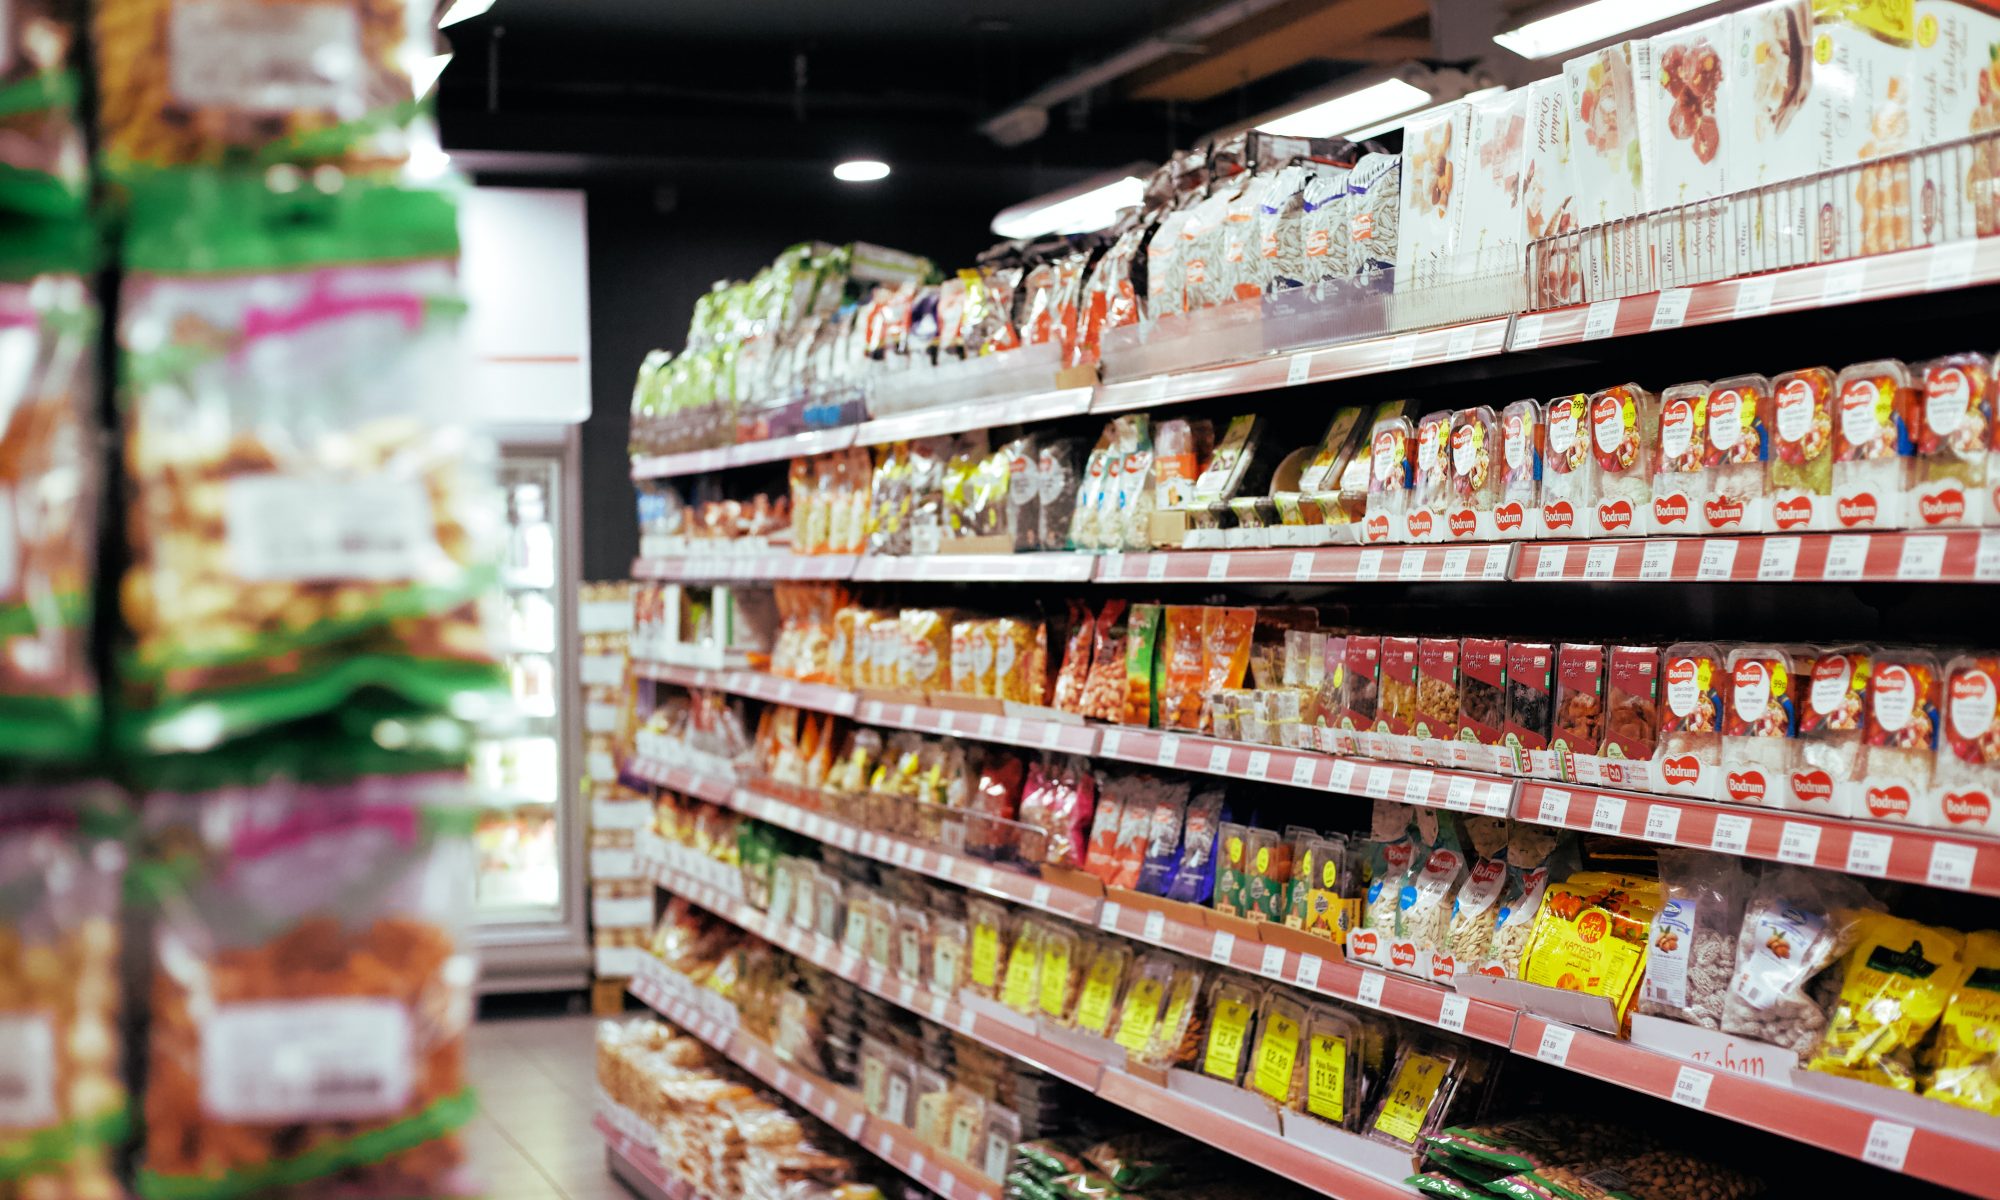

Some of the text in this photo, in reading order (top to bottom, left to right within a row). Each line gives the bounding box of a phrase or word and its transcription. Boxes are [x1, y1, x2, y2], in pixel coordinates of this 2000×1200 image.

[1537, 95, 1550, 153] Delight
[1551, 92, 1563, 145] Turkish
[1572, 401, 1584, 411] 99p
[1595, 407, 1615, 419] Bodrum
[1664, 411, 1686, 421] Bodrum
[1656, 503, 1686, 517] Bodrum
[1706, 506, 1741, 520] Bodrum
[1840, 503, 1875, 517] Bodrum
[1922, 500, 1963, 514] Bodrum
[1496, 512, 1522, 524] Bodrum
[1545, 510, 1572, 523] Bodrum
[1601, 510, 1630, 523] Bodrum
[1776, 507, 1810, 521] Bodrum
[1367, 522, 1388, 534] Bodrum
[1410, 519, 1431, 531] Bodrum
[1450, 518, 1475, 530] Bodrum
[1588, 560, 1601, 569] £1.79
[1669, 670, 1692, 679] Bodrum
[1736, 672, 1760, 682] Bodrum
[1773, 679, 1785, 689] 99p
[1875, 677, 1905, 689] Bodrum
[1665, 766, 1697, 778] Bodrum
[1730, 781, 1763, 794] Bodrum
[1794, 780, 1831, 794] Bodrum
[1869, 794, 1908, 811] Bodrum
[1947, 799, 1987, 817] Bodrum
[1353, 940, 1377, 951] Bodrum
[1392, 949, 1415, 961] Bodrum
[1316, 1070, 1336, 1091] £1.99
